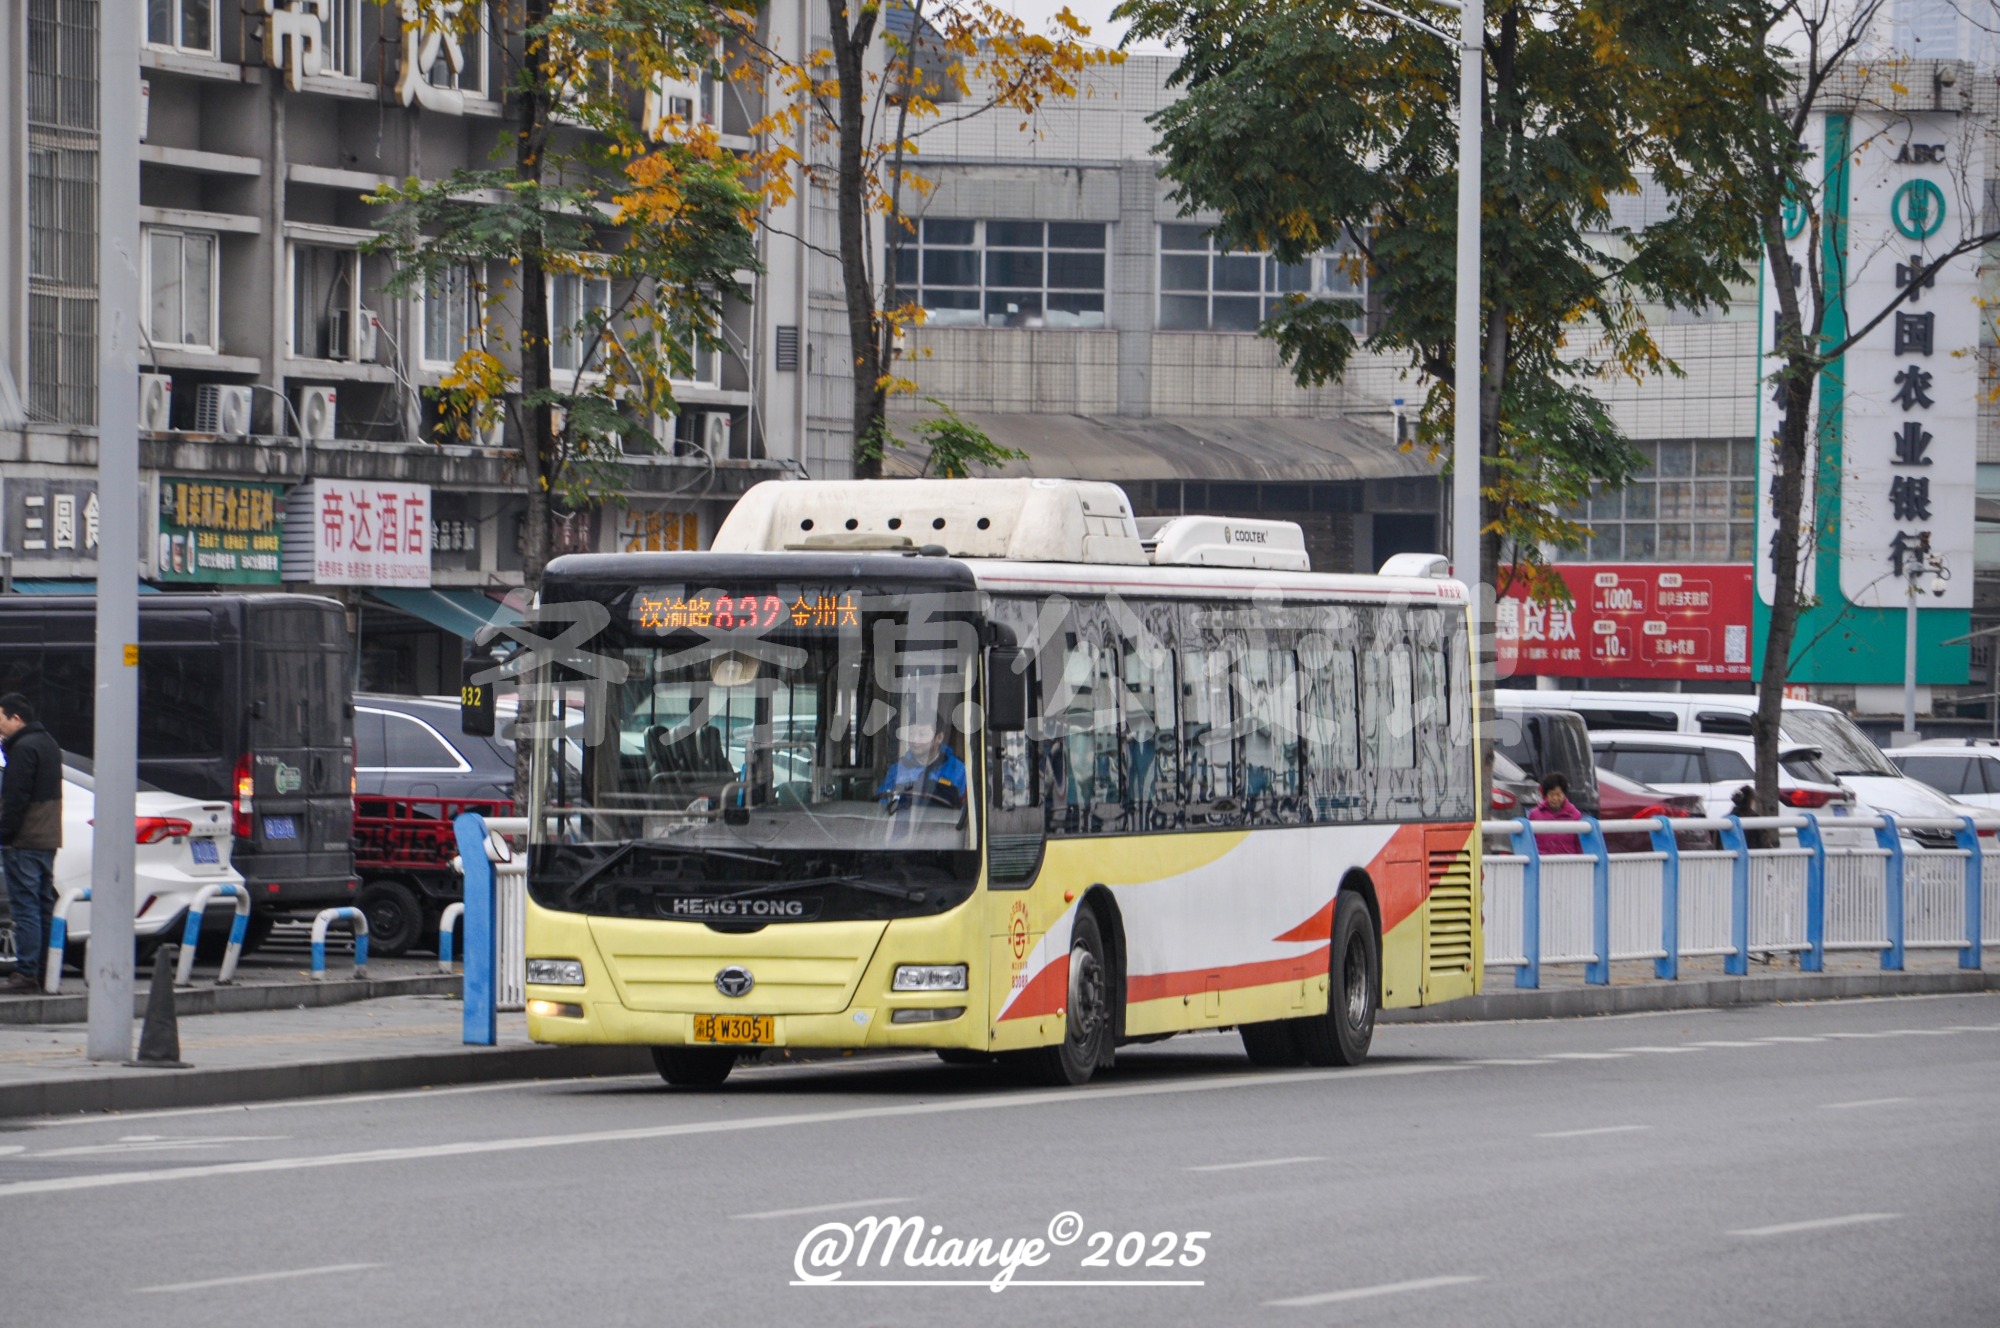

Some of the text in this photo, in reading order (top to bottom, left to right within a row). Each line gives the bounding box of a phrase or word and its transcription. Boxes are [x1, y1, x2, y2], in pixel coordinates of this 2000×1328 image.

[1893, 142, 1946, 165] ABC
[1888, 254, 1936, 577] 中国农业银行
[322, 488, 424, 554] 帝达酒店
[462, 686, 482, 706] 832
[673, 898, 803, 915] HENGTONG
